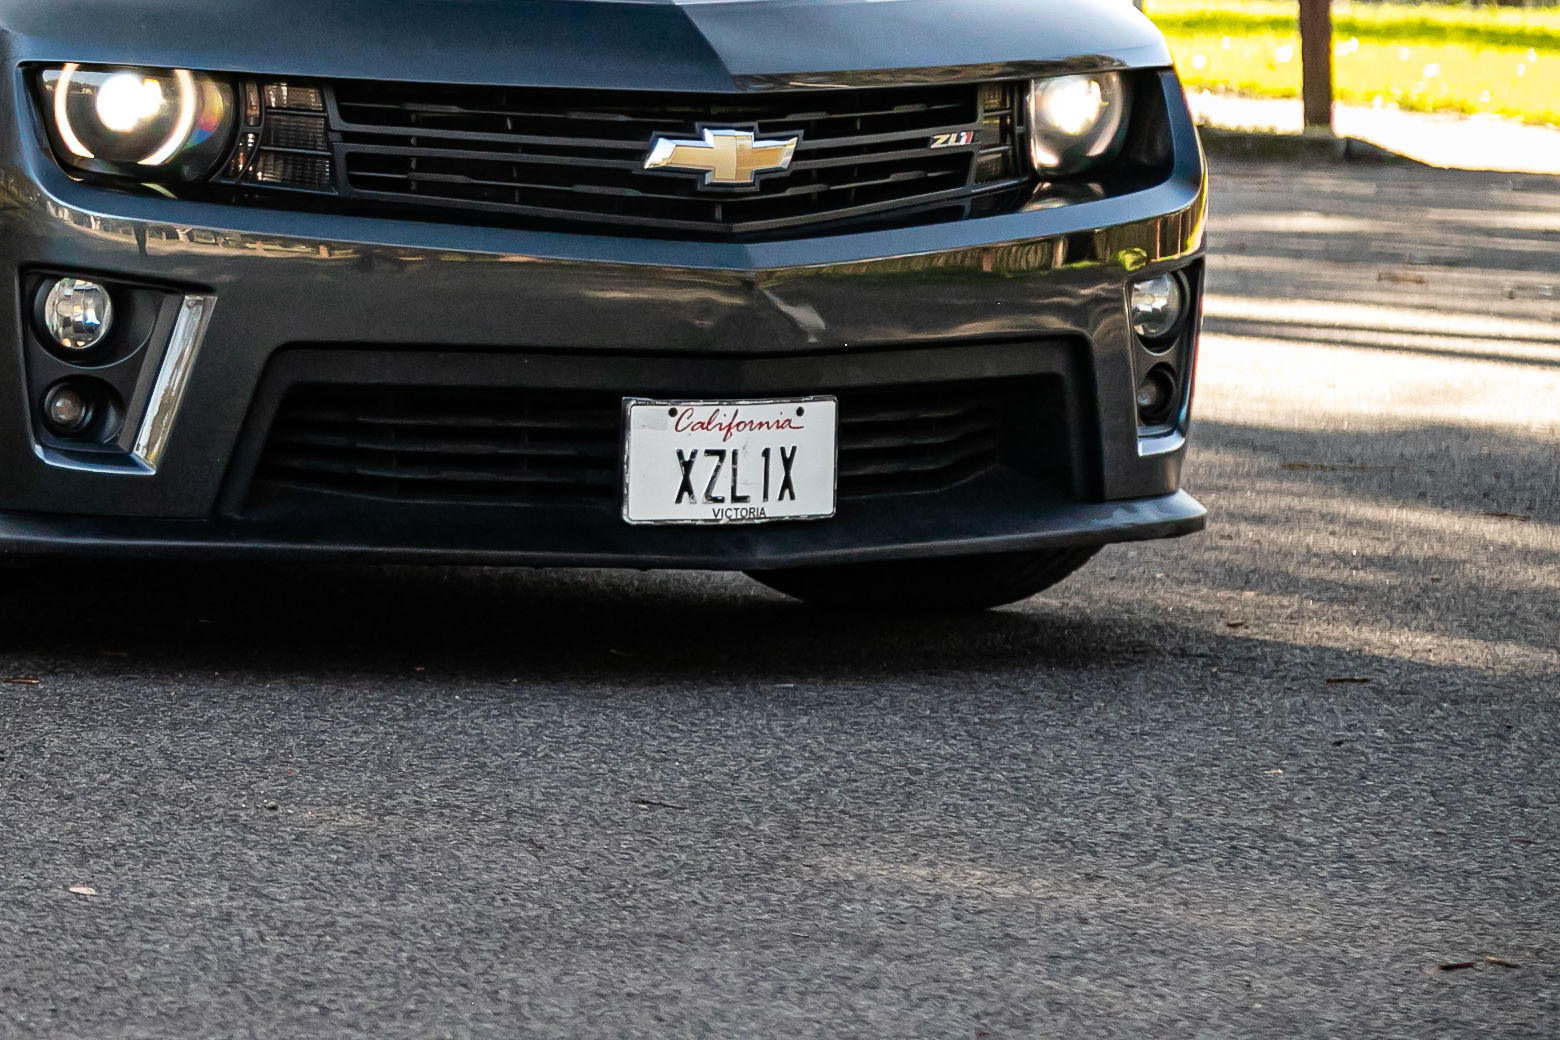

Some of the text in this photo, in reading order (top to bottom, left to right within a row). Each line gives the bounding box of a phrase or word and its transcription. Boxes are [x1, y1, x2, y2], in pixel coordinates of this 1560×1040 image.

[931, 131, 974, 148] ZL1
[675, 408, 804, 442] California
[675, 446, 797, 504] XZL1X
[712, 507, 767, 518] VICTORIA
